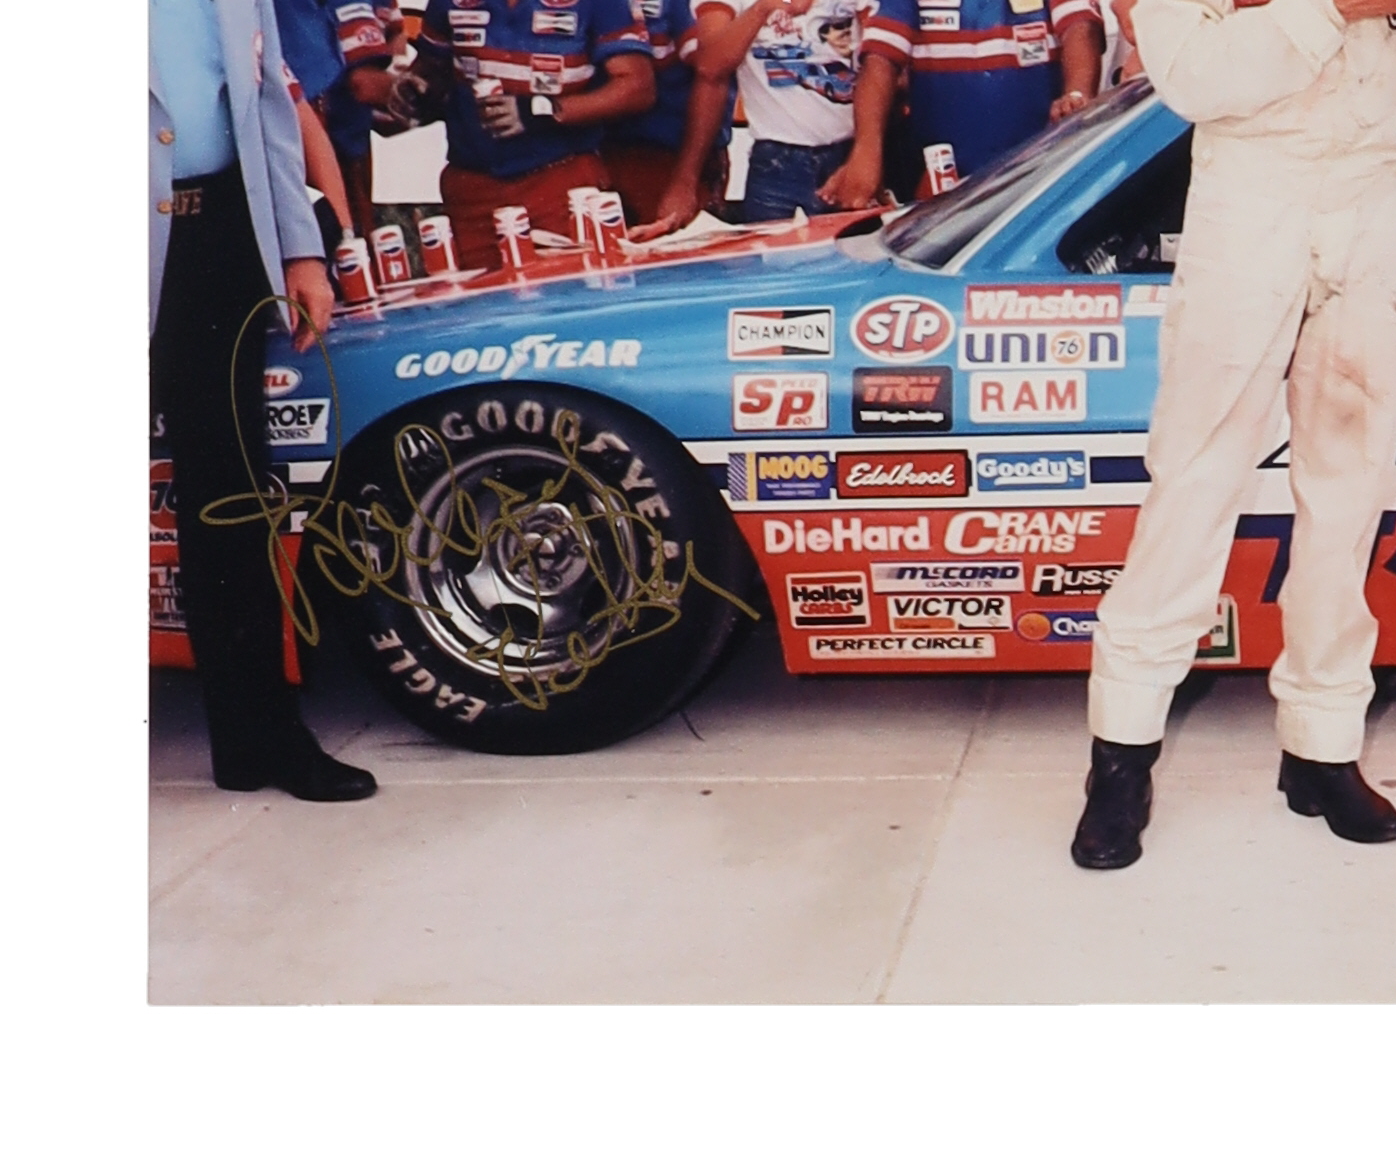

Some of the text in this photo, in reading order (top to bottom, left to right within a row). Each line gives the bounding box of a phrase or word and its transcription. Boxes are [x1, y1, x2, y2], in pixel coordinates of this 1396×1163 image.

[969, 289, 1119, 321] Winston
[738, 324, 826, 341] CHAMPION
[864, 301, 940, 349] STP
[395, 334, 641, 379] GOODYEAR
[981, 379, 1077, 412] RAM
[758, 454, 830, 480] MOOG
[845, 461, 956, 488] Edelbrock
[977, 456, 1086, 486] Goody's
[764, 516, 931, 555] DieHard
[791, 583, 864, 607] Holley
[893, 597, 1005, 617] VICTOR
[815, 636, 986, 652] PERFECT CIRCLE
[369, 628, 488, 724] EAGLE
